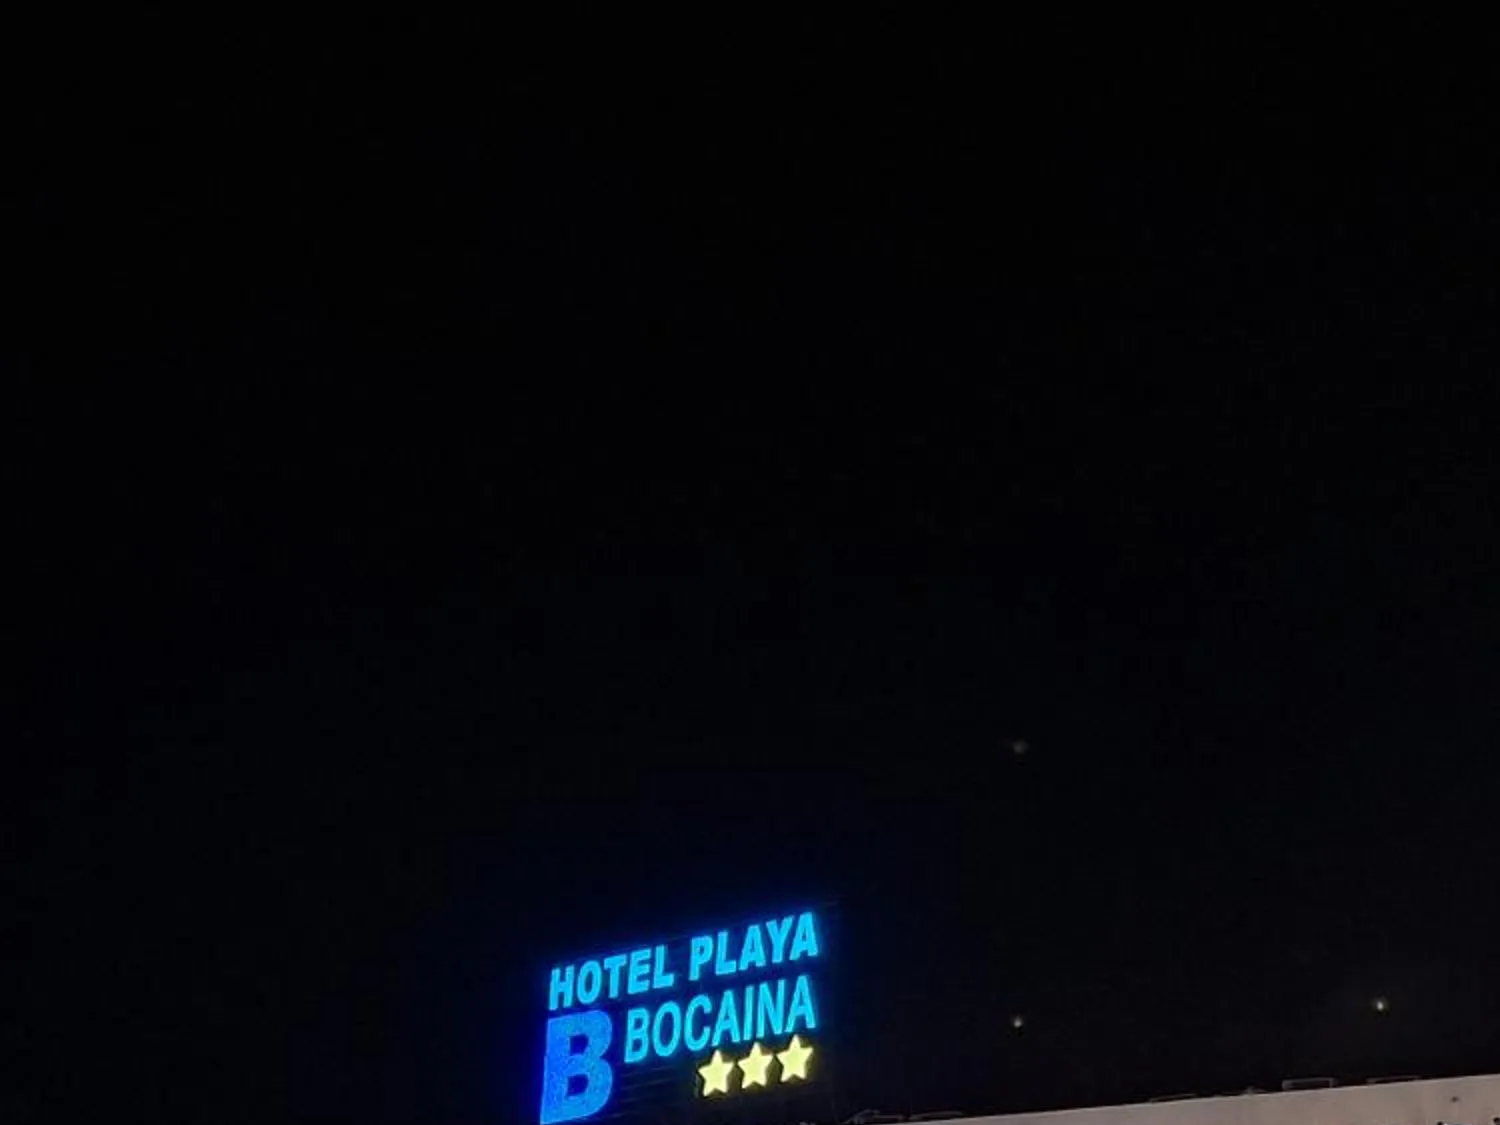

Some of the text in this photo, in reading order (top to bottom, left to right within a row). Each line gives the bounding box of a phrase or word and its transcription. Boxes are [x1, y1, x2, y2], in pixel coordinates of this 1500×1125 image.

[548, 911, 819, 1011] HOTEL PLAYA
[540, 1010, 613, 1125] B
[624, 975, 817, 1063] BOCAINA
